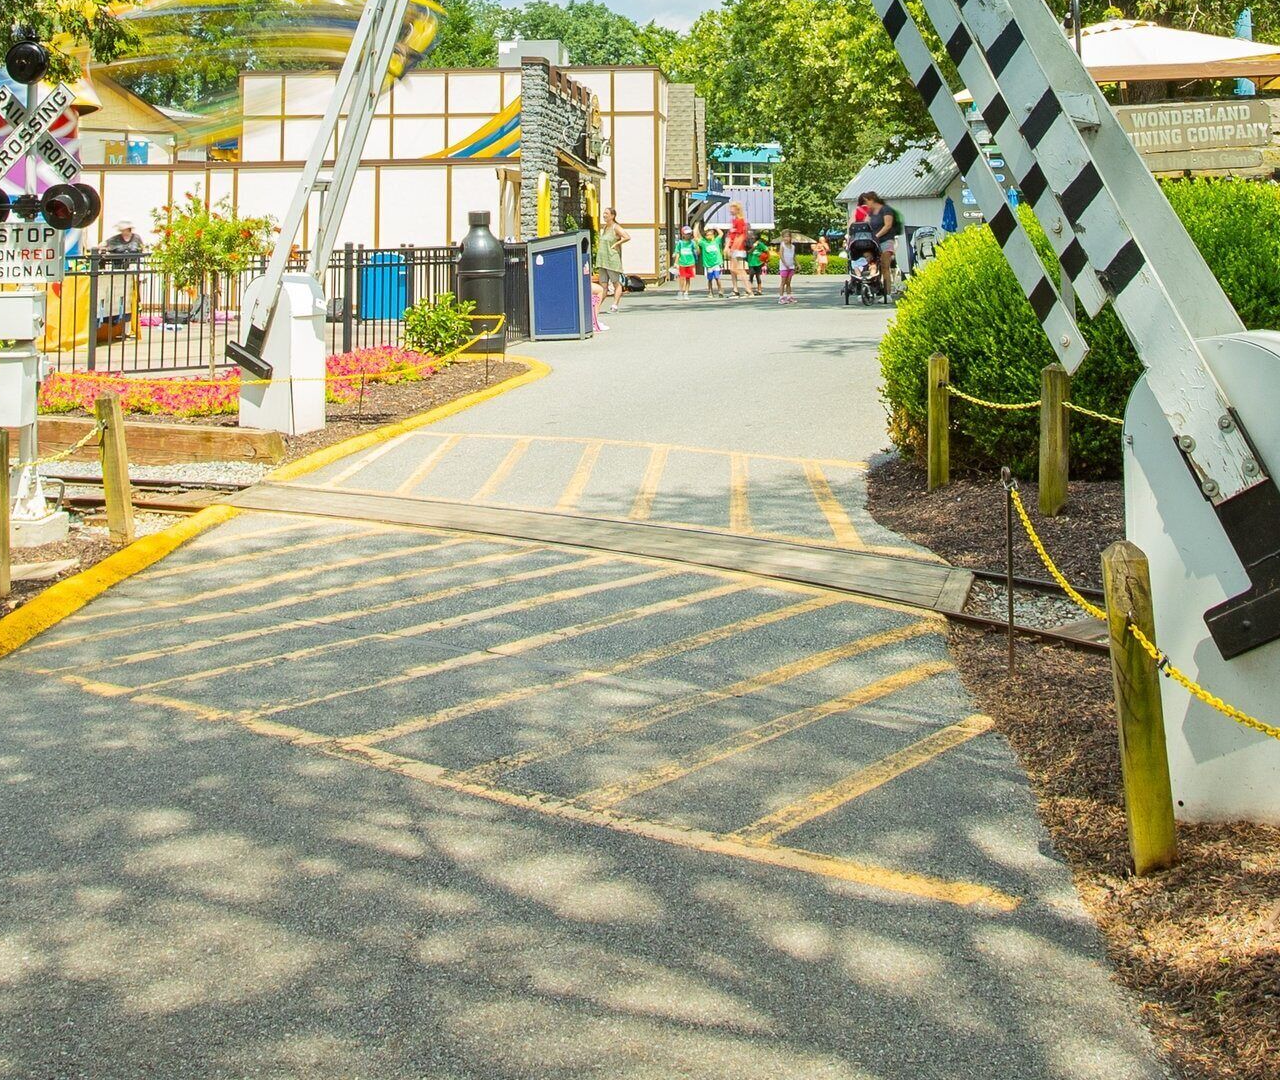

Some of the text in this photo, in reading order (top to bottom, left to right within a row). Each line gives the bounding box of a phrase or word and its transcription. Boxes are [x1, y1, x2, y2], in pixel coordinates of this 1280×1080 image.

[1131, 105, 1250, 128] WONDERLAND
[1187, 123, 1269, 143] COMPANY
[39, 139, 77, 179] ROAD
[21, 248, 55, 260] RED
